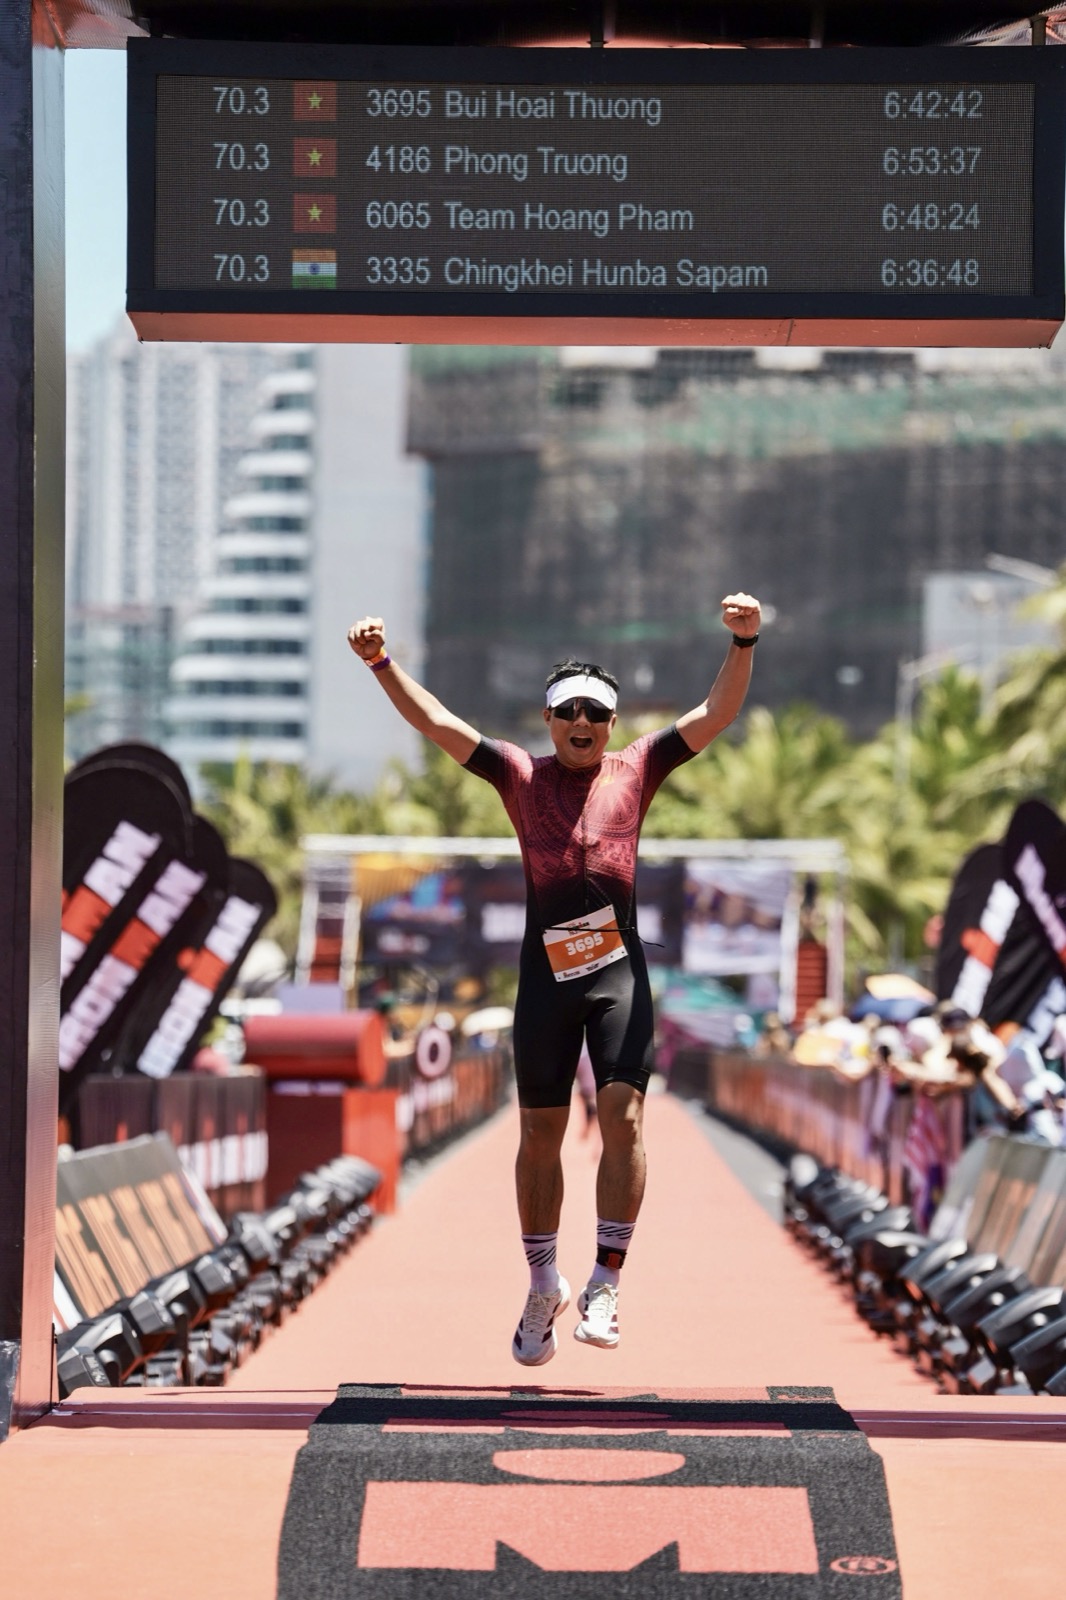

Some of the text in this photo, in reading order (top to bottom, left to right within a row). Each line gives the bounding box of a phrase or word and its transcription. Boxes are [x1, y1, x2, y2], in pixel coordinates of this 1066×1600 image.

[214, 87, 983, 126] 70.3 3695 Bui Hoai Thuong 6:42:42
[214, 143, 981, 182] 70.3 4186 Phong Truong 6:53:37
[214, 198, 980, 238] 70.3 6065 Team Hoang Pham 6:48:24
[214, 254, 979, 292] 70.3 3335 Chingkhei Hunba Sapam 6:36:48
[565, 932, 605, 956] 3695
